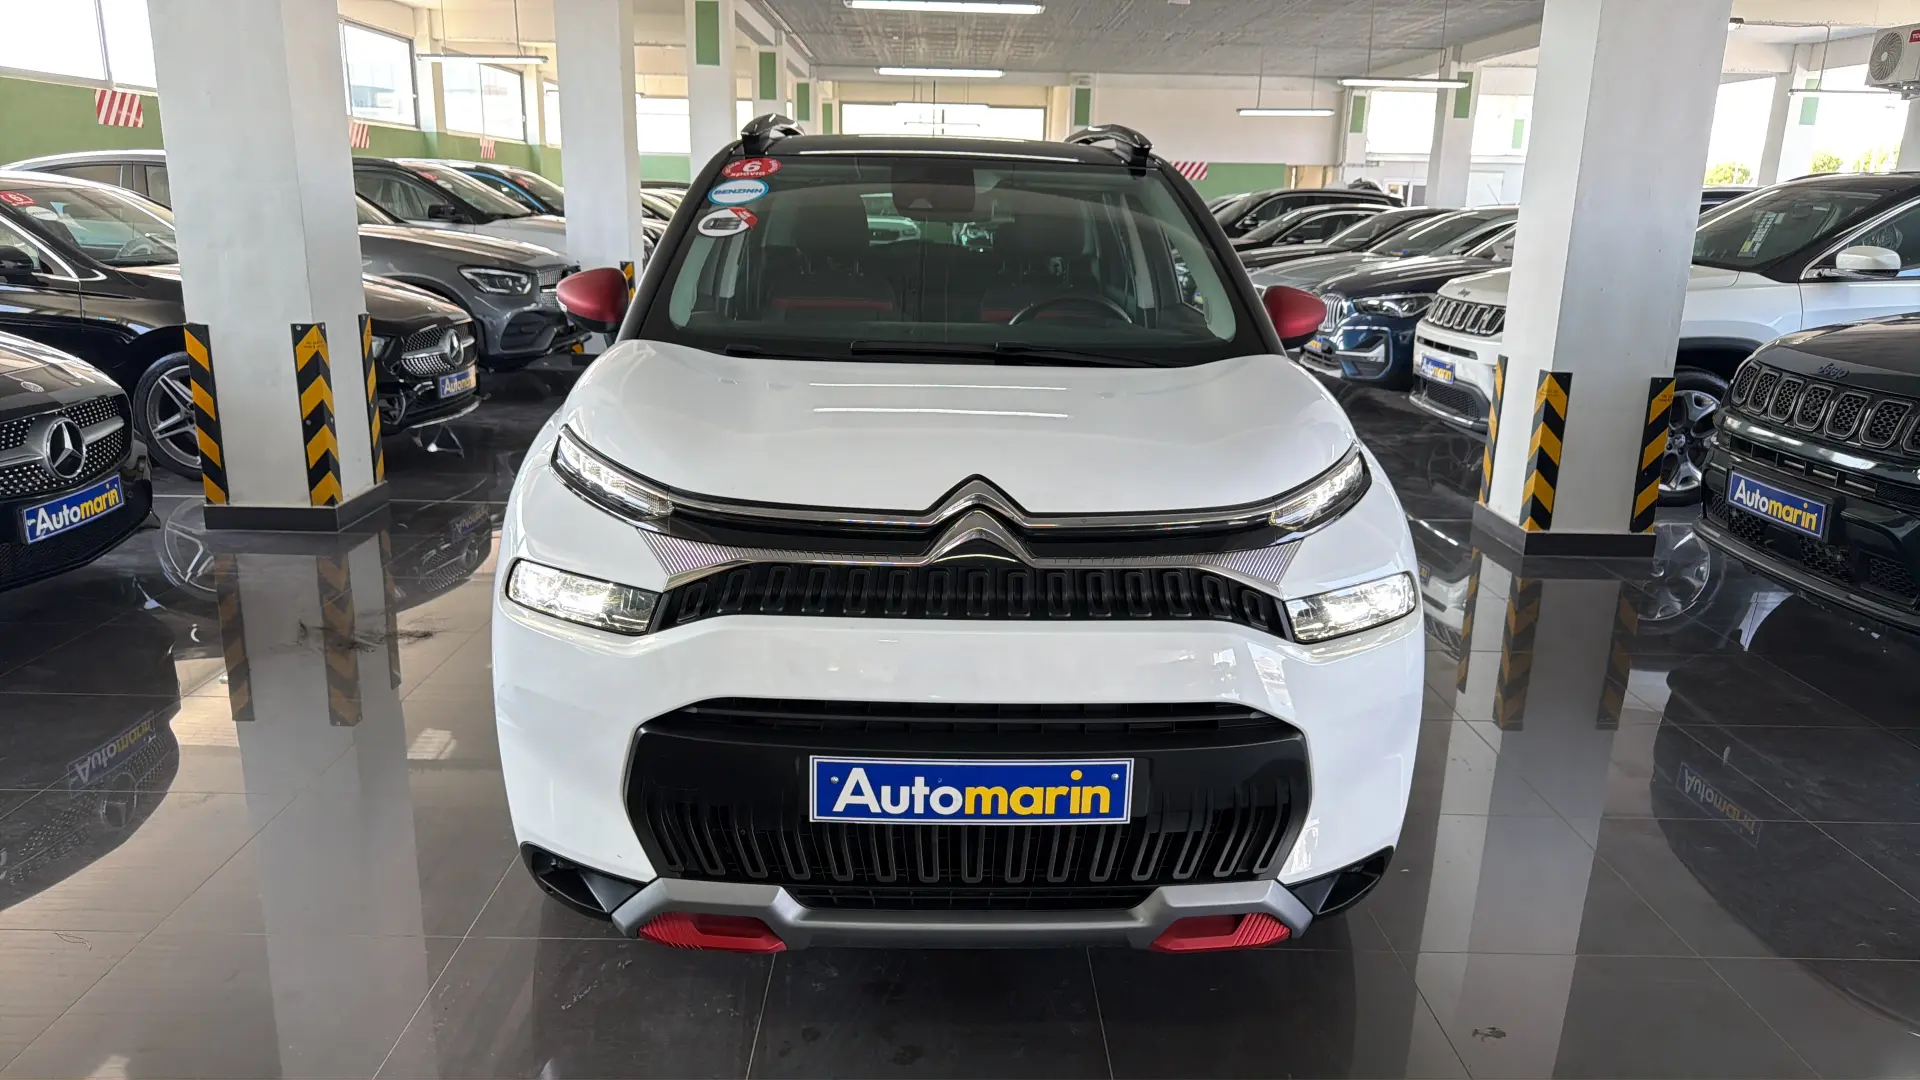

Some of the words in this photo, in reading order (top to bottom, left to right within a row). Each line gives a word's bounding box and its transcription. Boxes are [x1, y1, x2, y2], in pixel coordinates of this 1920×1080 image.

[742, 160, 762, 172] 6
[1819, 362, 1850, 380] Jeep
[35, 482, 120, 537] Automarin
[1733, 478, 1817, 532] Automarin
[832, 767, 1110, 816] Automarin
